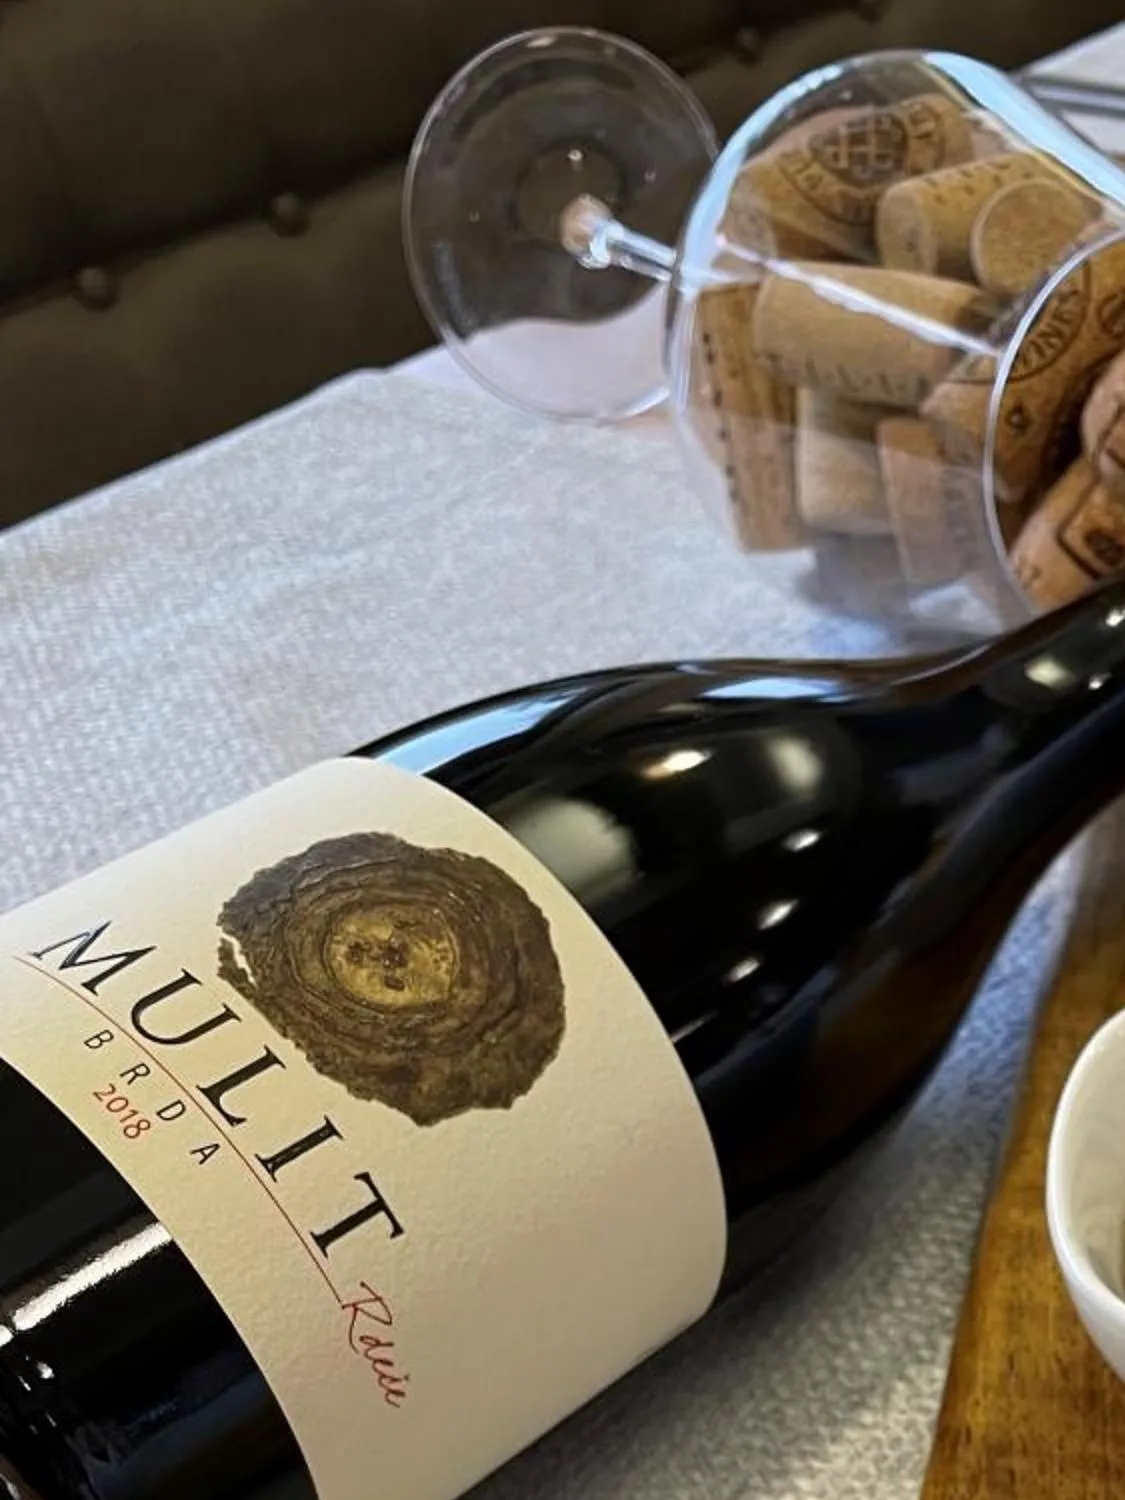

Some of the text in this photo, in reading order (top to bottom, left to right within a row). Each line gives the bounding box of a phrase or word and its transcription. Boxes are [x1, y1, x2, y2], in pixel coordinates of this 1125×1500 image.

[31, 920, 404, 1258] MULIT
[83, 1029, 221, 1165] BRDA
[93, 1083, 152, 1140] 2018
